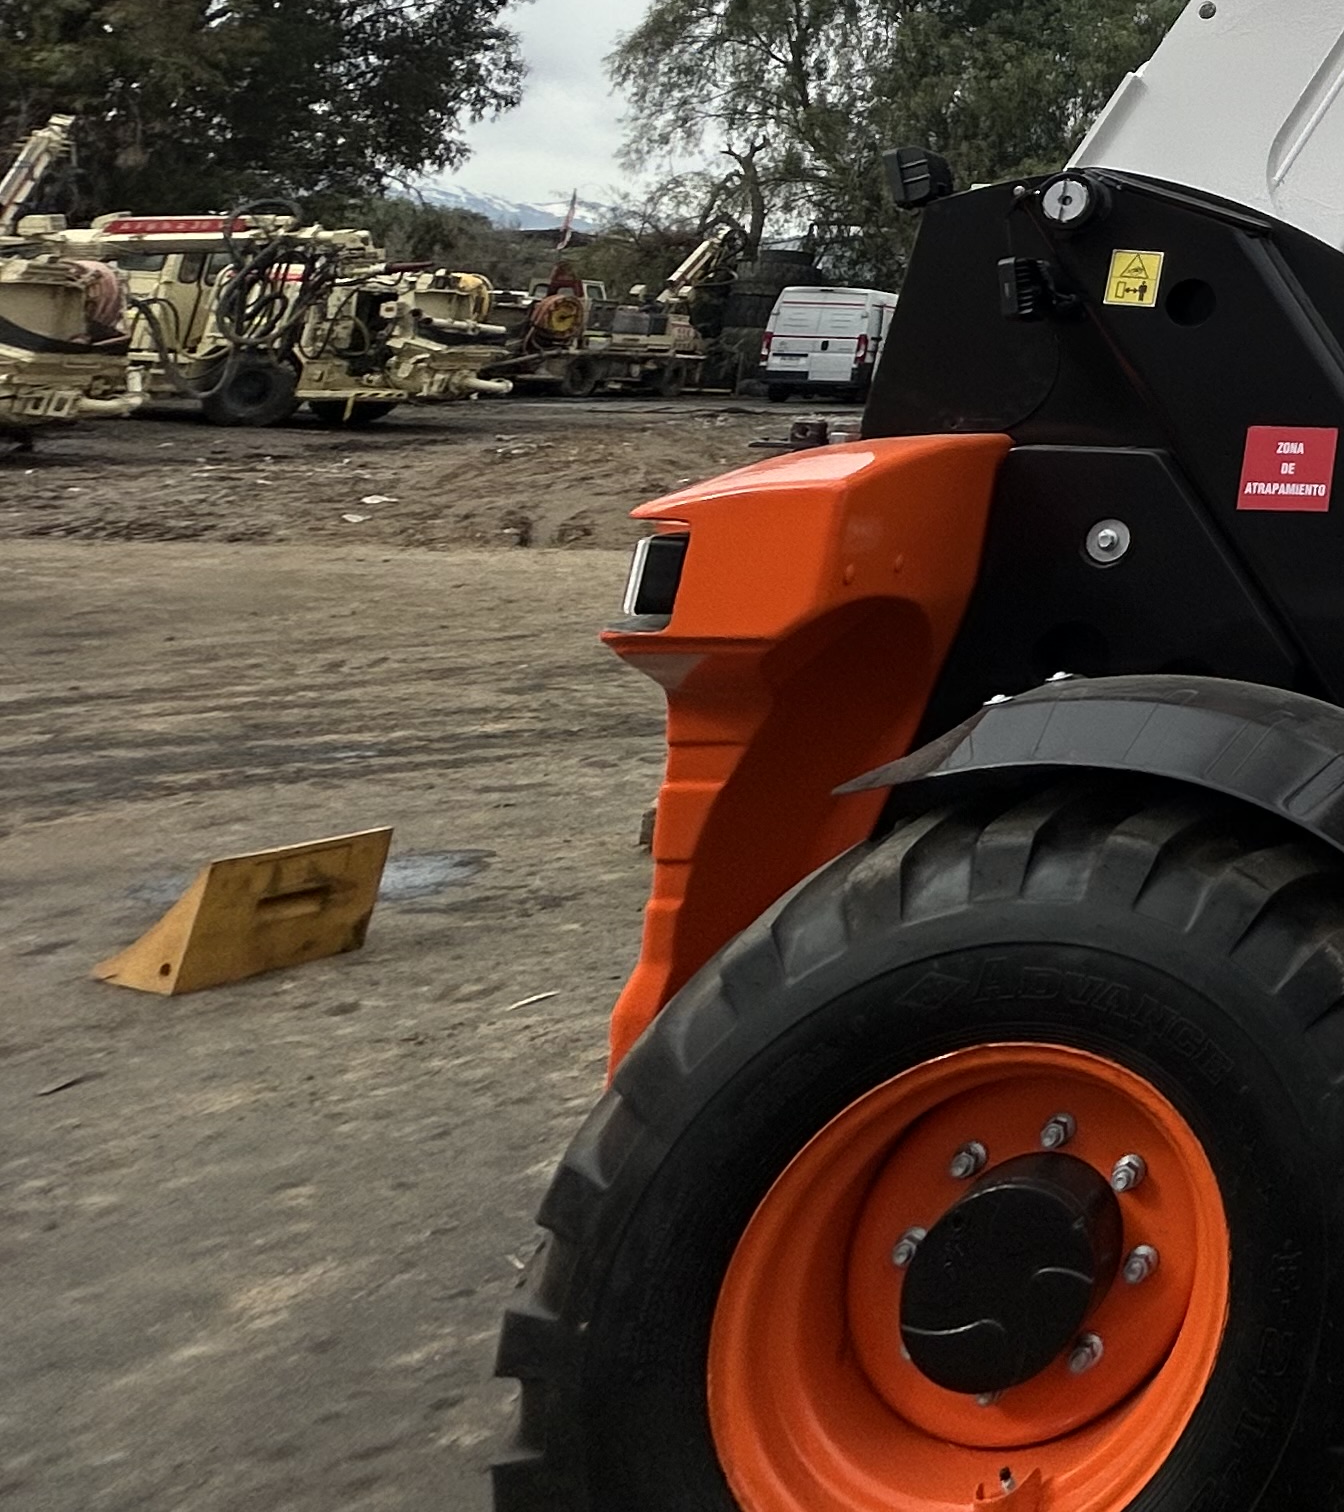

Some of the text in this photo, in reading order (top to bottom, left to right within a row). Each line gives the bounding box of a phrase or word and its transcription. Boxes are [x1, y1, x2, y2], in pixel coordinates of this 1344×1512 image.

[1276, 441, 1305, 455] ZONA
[1280, 462, 1296, 475] DE
[1243, 482, 1326, 497] ATRAPAMIENTO
